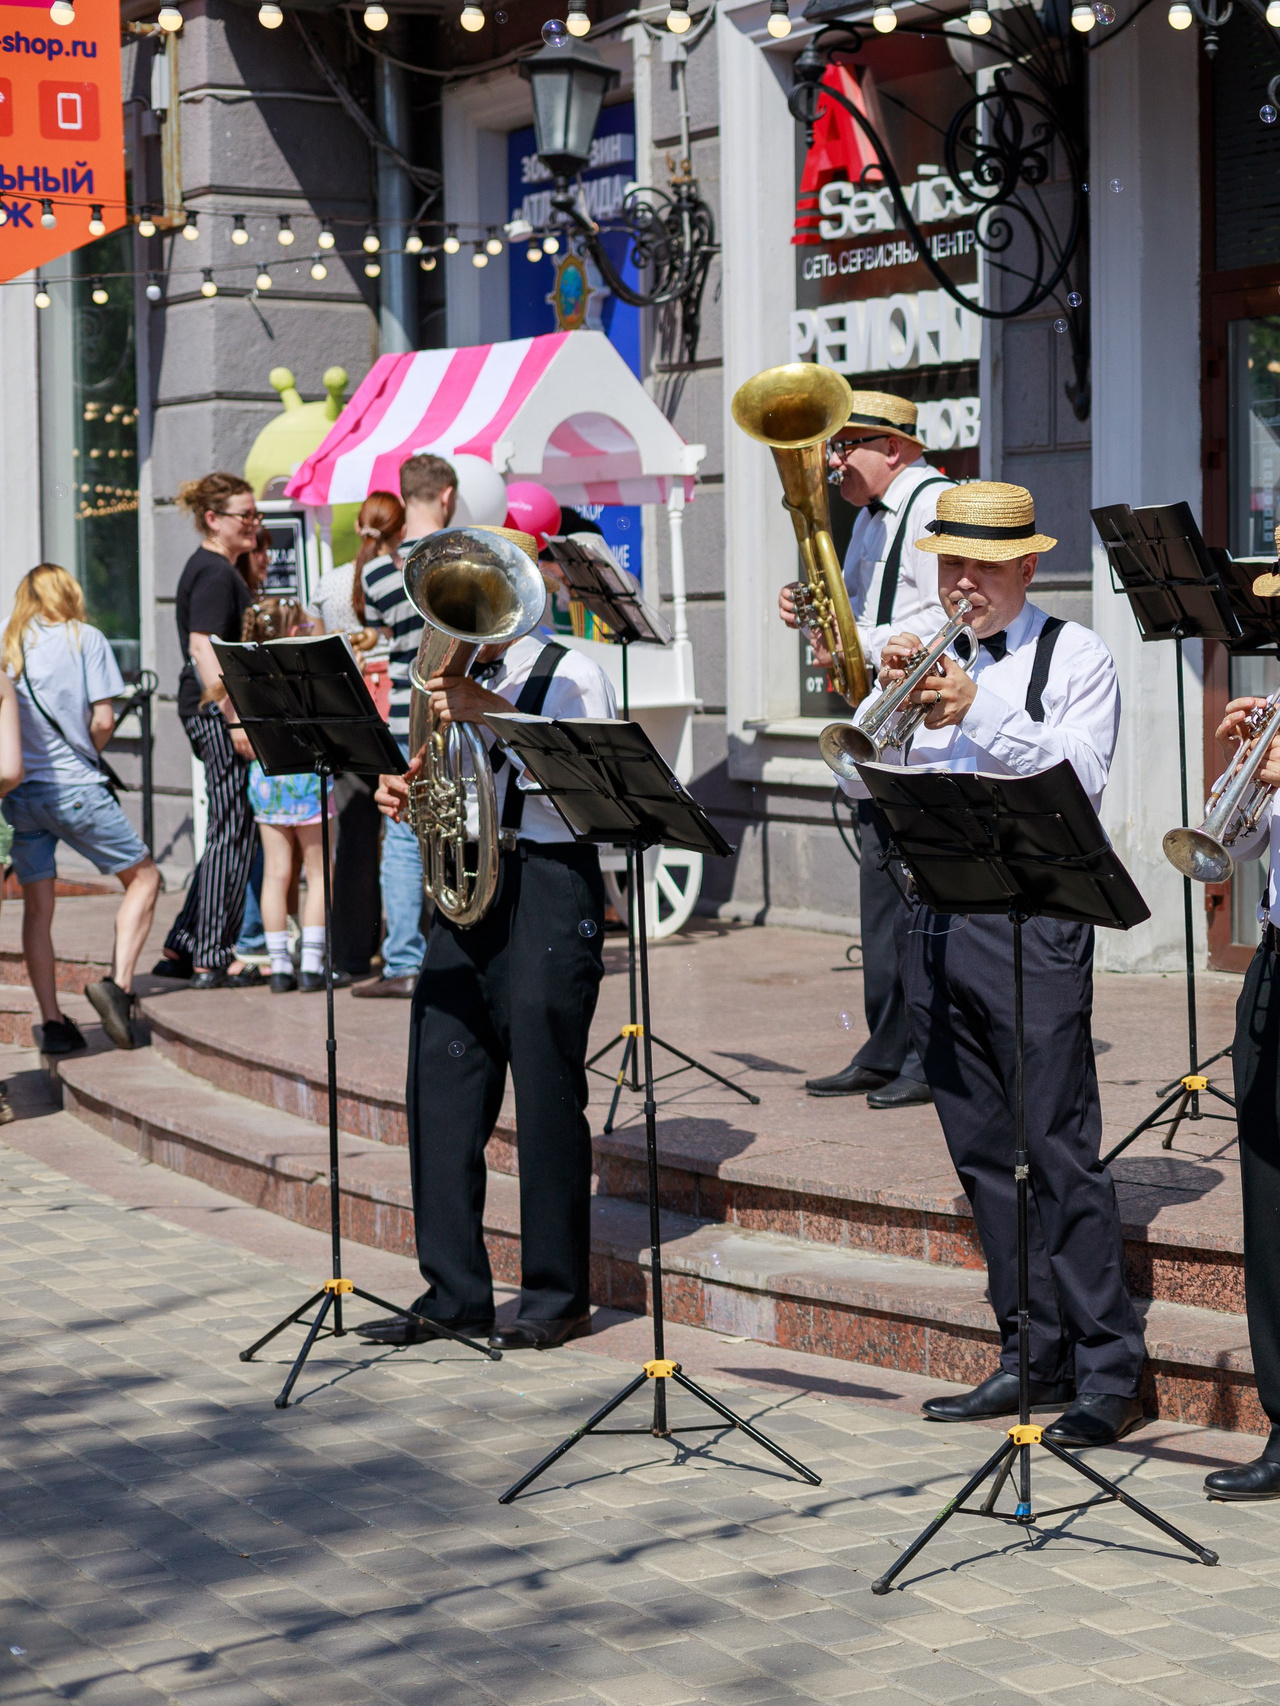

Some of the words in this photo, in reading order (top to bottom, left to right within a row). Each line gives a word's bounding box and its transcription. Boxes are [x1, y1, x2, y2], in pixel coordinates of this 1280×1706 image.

[0, 161, 94, 194] ЬНЫЙ
[803, 252, 837, 280] СЕТЬ
[926, 229, 979, 262] ЦЕНТР
[790, 283, 982, 376] РЕМОНТ
